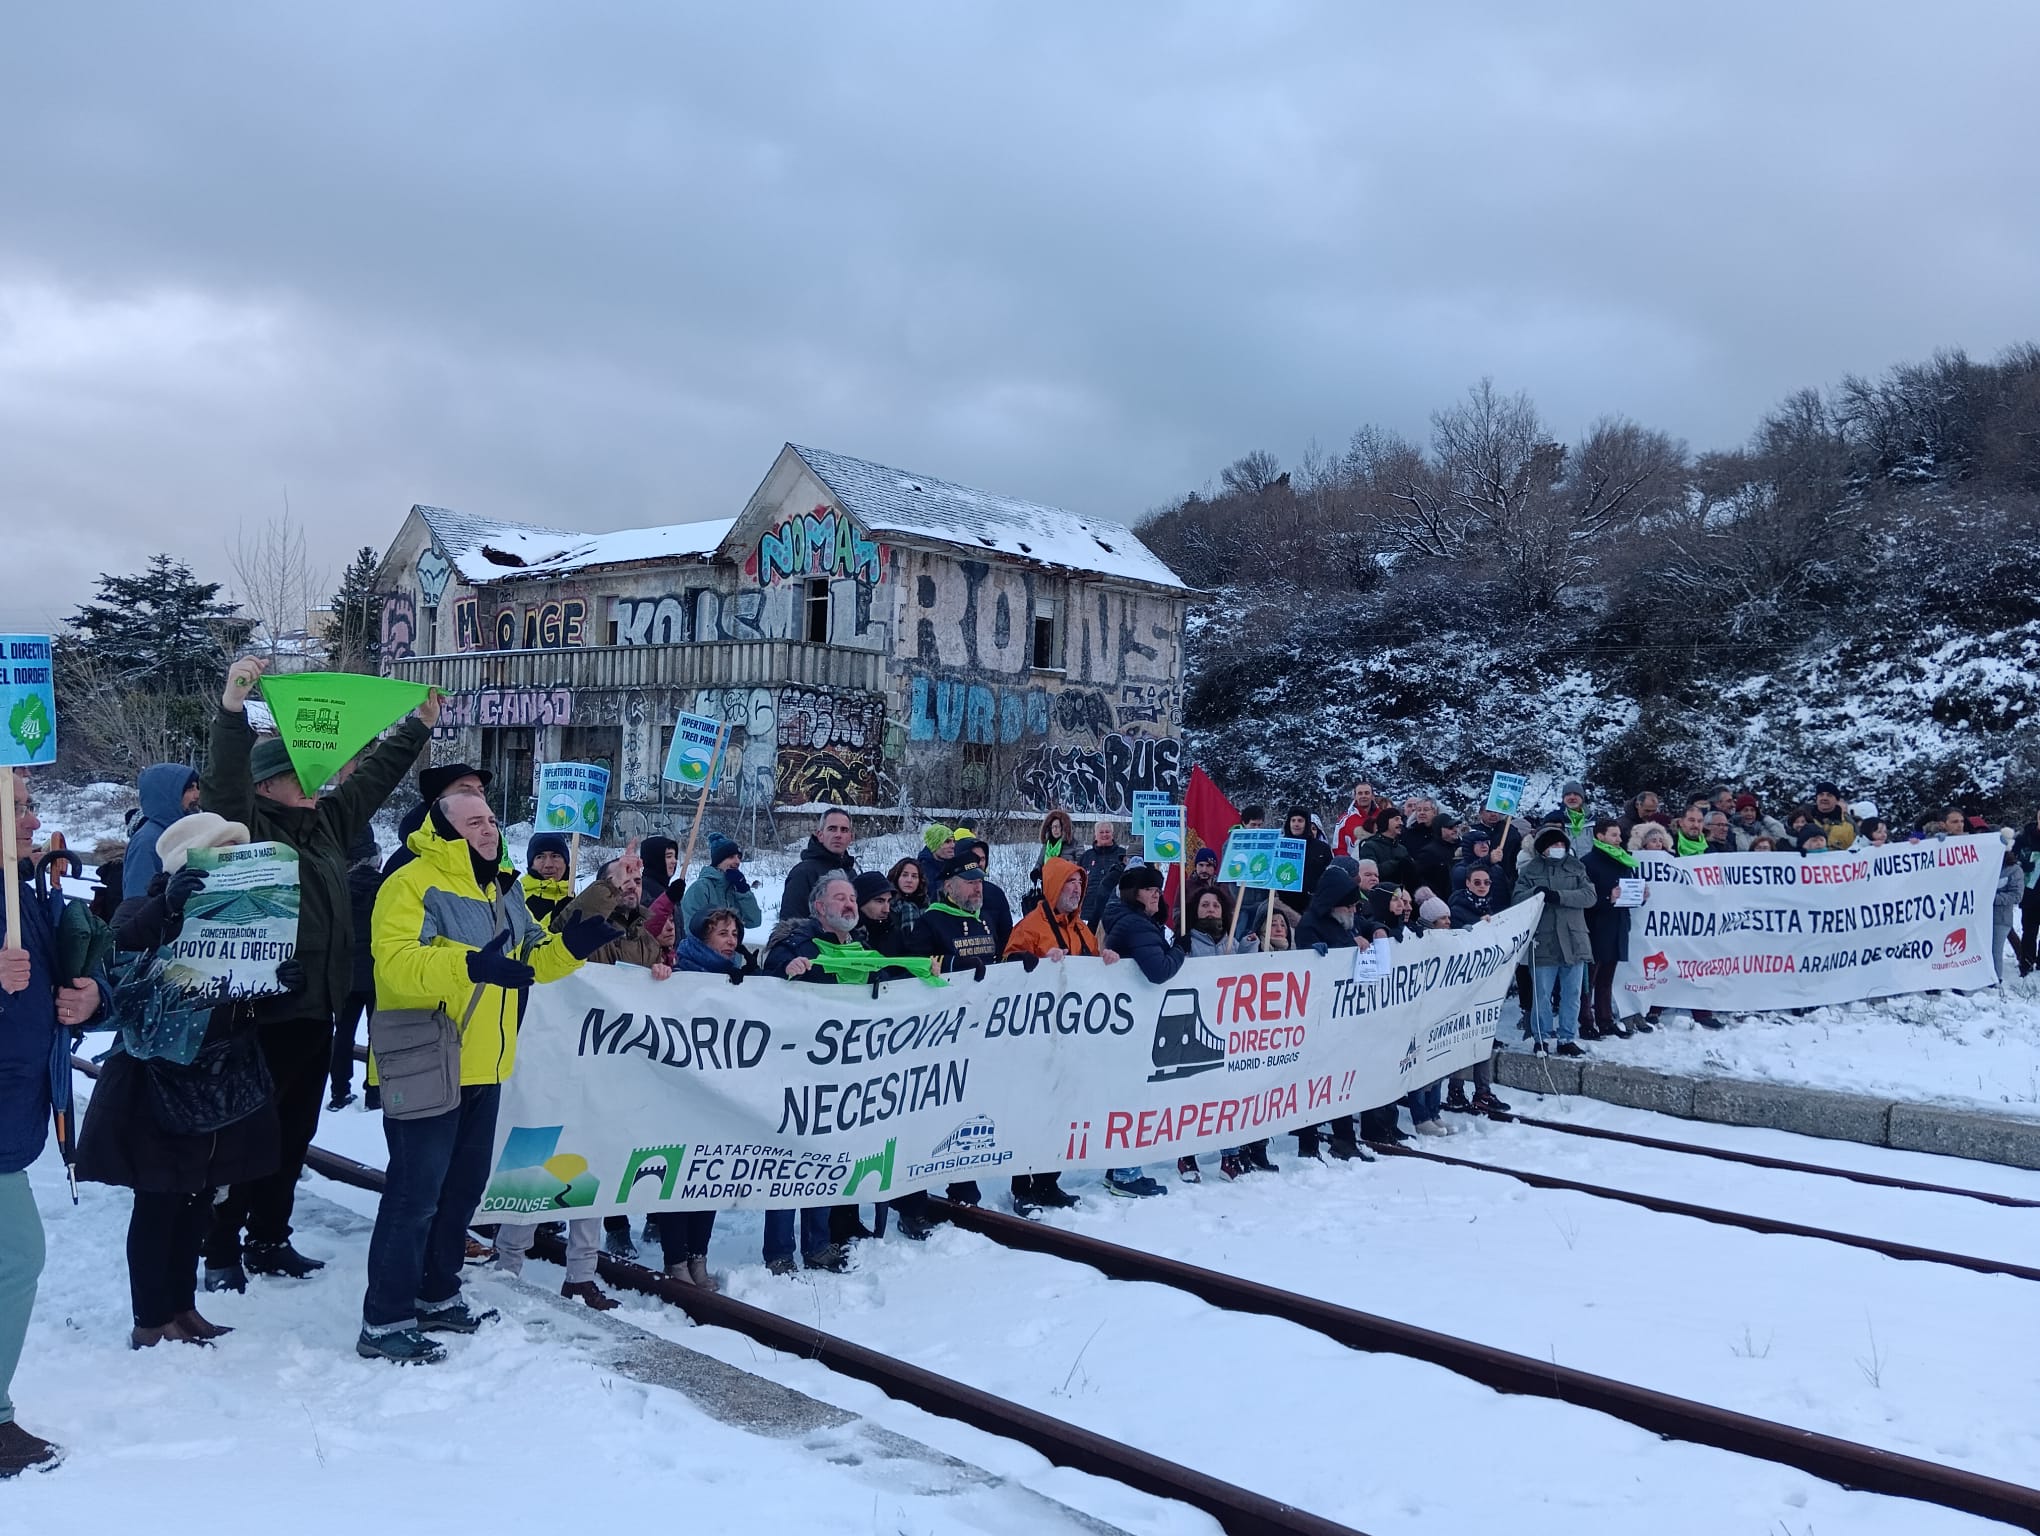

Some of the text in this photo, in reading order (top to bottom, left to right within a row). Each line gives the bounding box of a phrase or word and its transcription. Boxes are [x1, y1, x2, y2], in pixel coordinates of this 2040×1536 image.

[681, 716, 715, 734] APERTURA
[292, 739, 321, 749] DIRECTO
[681, 730, 699, 745] TREN
[574, 768, 587, 778] DEL
[559, 780, 577, 790] PARA
[579, 781, 586, 792] EL
[1147, 809, 1177, 817] APERTURA
[254, 849, 258, 858] 3
[259, 847, 277, 857] MARZO
[1724, 865, 1796, 886] NUESTRO
[1800, 860, 1871, 885] DERECHO,
[1873, 850, 1935, 877] NUESTRA
[1938, 844, 1980, 867] LUCHA
[1644, 889, 1975, 936] ARANDA NECESITA TREN DIRECTO ¡YA!
[200, 926, 268, 939] CONCENTRACIÓN DE
[171, 939, 294, 962] APOYO AL DIRECTO
[1959, 954, 1982, 967] unida
[1676, 955, 1740, 982] IZQUIERDA
[1743, 955, 1796, 974] UNIDA
[1799, 950, 1857, 974] ARANDA
[1861, 947, 1882, 966] DE
[1331, 978, 1377, 1019] TREN
[1379, 956, 1441, 1009] DIRECTO
[1440, 944, 1505, 989] MADRID
[1216, 970, 1311, 1026] TREN
[577, 1007, 772, 1071] MADRID
[806, 1006, 967, 1066] SEGOVIA
[984, 991, 1135, 1039] BURGOS
[1428, 1012, 1471, 1044] SONORAMA
[1228, 1025, 1305, 1055] DIRECTO
[1228, 1057, 1261, 1073] MADRID
[1266, 1051, 1300, 1067] BURGOS
[776, 1058, 969, 1136] NECESITAN
[1104, 1082, 1298, 1150] REAPERTURA
[1307, 1074, 1333, 1110] YA
[694, 1144, 852, 1164] PLATAFORMA POR EL
[906, 1150, 1013, 1178] Translozoya
[686, 1158, 848, 1182] FC DIRECTO
[681, 1183, 753, 1200] MADRID
[769, 1182, 839, 1198] BURGOS
[482, 1196, 551, 1212] CODINSE
